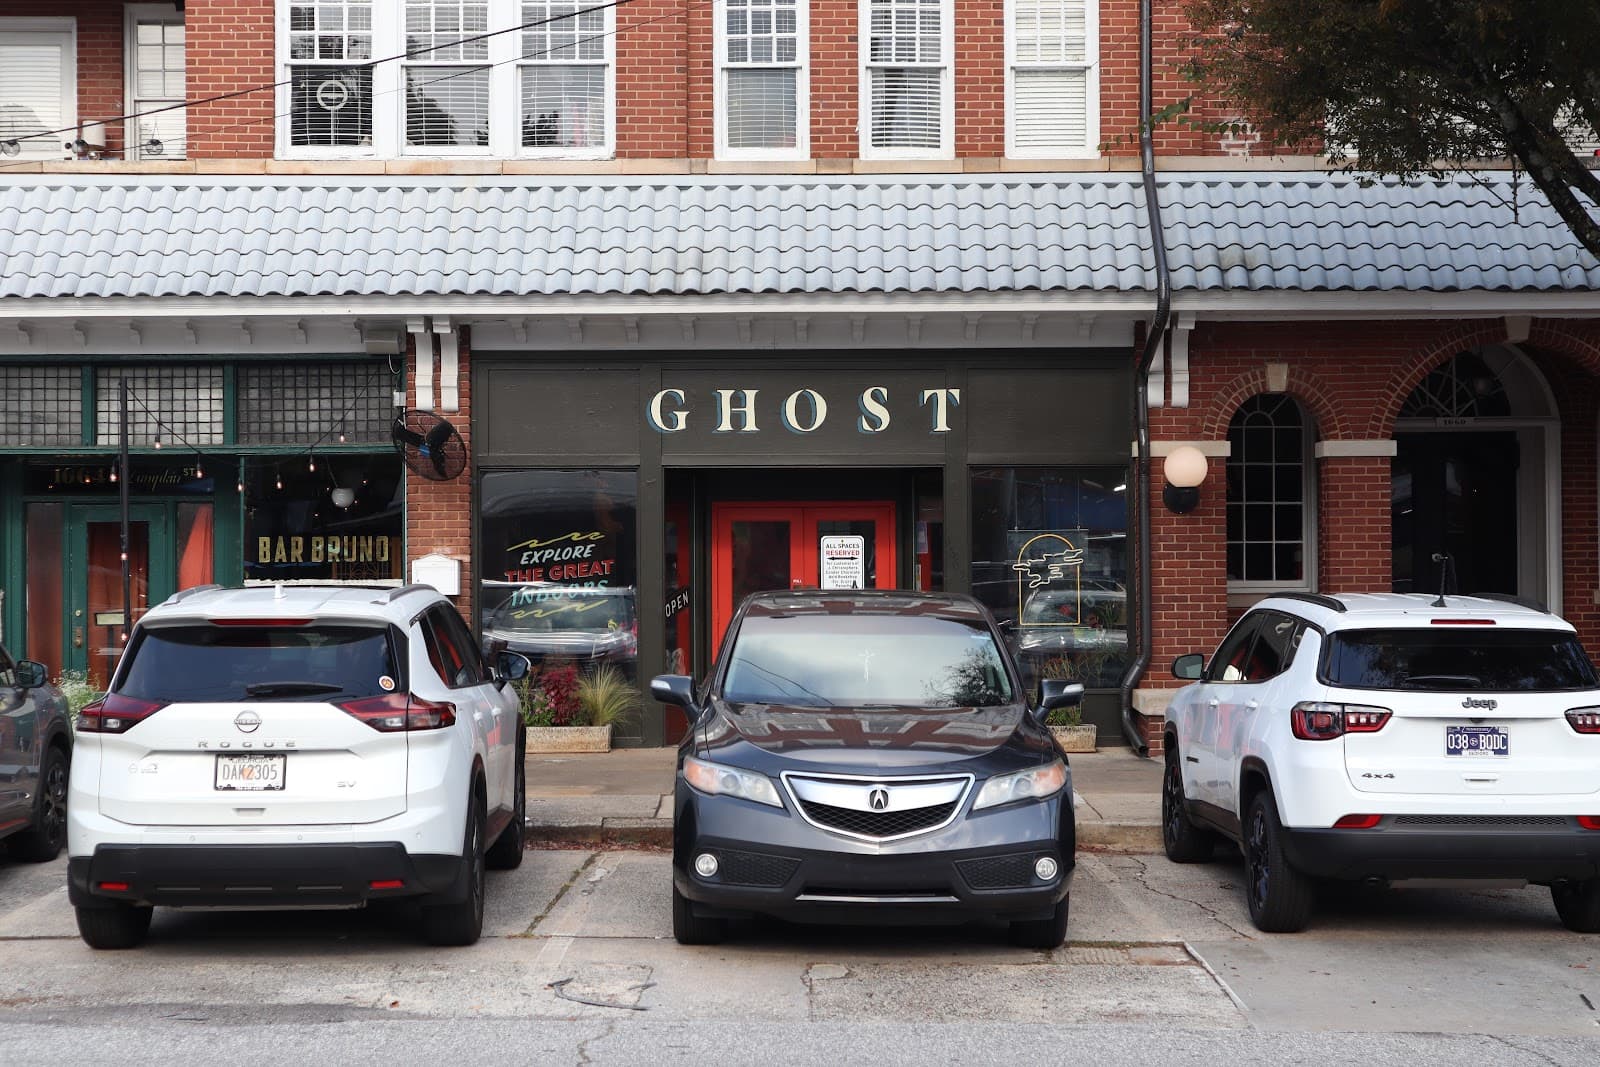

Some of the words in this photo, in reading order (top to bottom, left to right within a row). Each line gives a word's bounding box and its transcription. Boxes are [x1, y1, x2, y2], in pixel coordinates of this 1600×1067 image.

[646, 386, 961, 434] GHOST
[258, 536, 304, 562] BAR
[311, 535, 389, 562] BRUNO
[520, 544, 596, 565] EXPLORE
[504, 567, 545, 583] THE
[549, 559, 615, 581] GREAT
[511, 580, 609, 607] INDOORS
[665, 591, 689, 618] OPEN
[1462, 697, 1498, 711] Jeep
[1448, 733, 1469, 749] 038
[222, 764, 278, 781] DAK2305
[336, 780, 358, 788] SV
